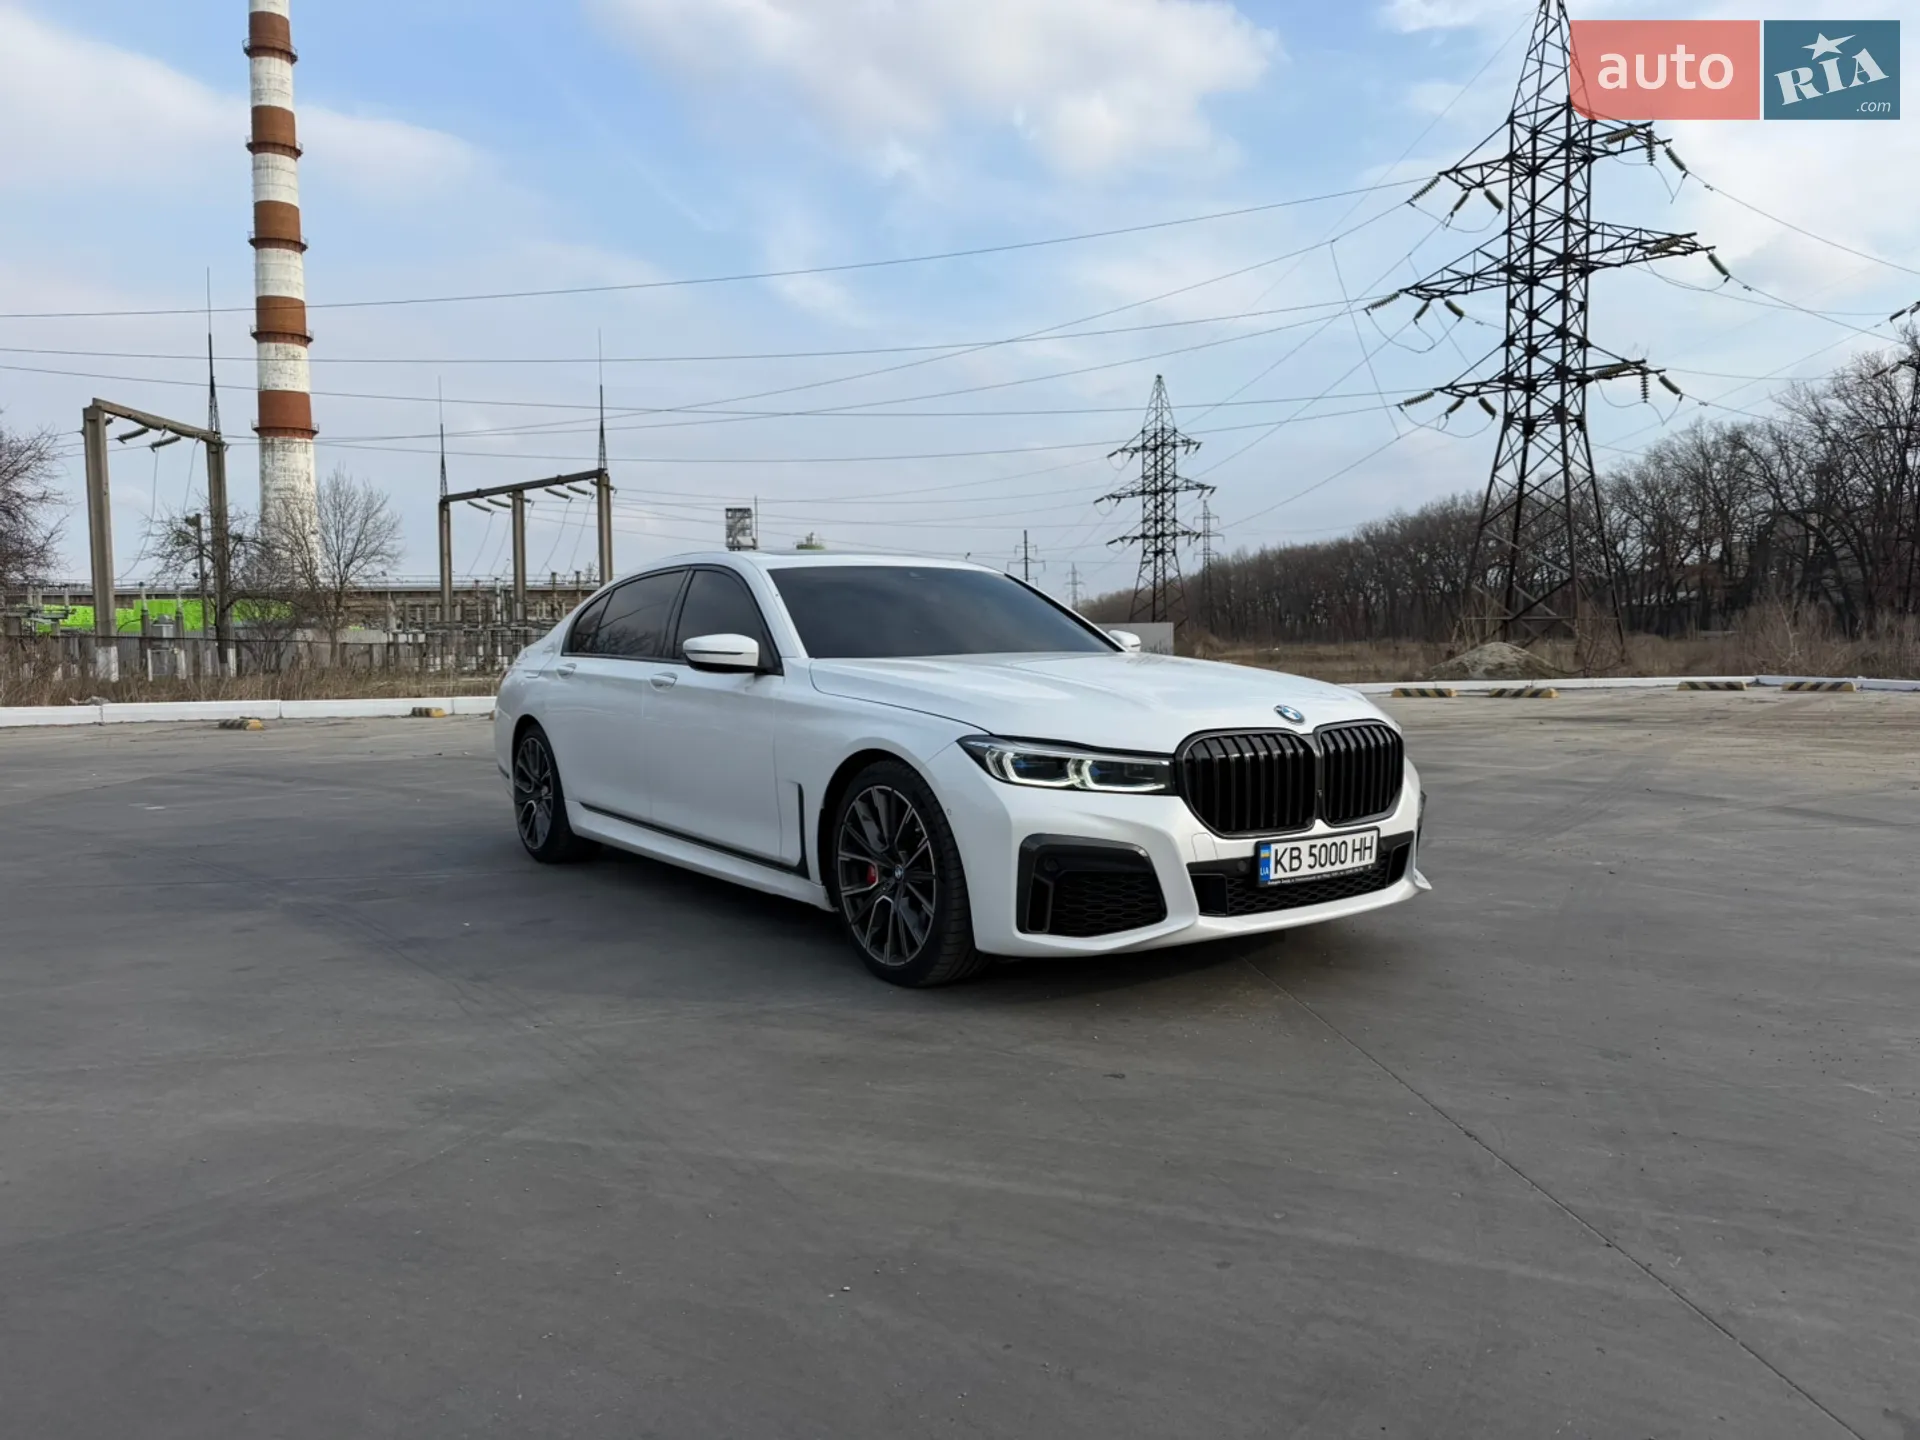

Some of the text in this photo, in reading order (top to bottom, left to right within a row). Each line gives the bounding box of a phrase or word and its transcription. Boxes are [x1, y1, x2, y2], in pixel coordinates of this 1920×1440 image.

[1274, 846, 1303, 875] KB
[1308, 840, 1348, 870] 5000
[1351, 835, 1374, 863] HH
